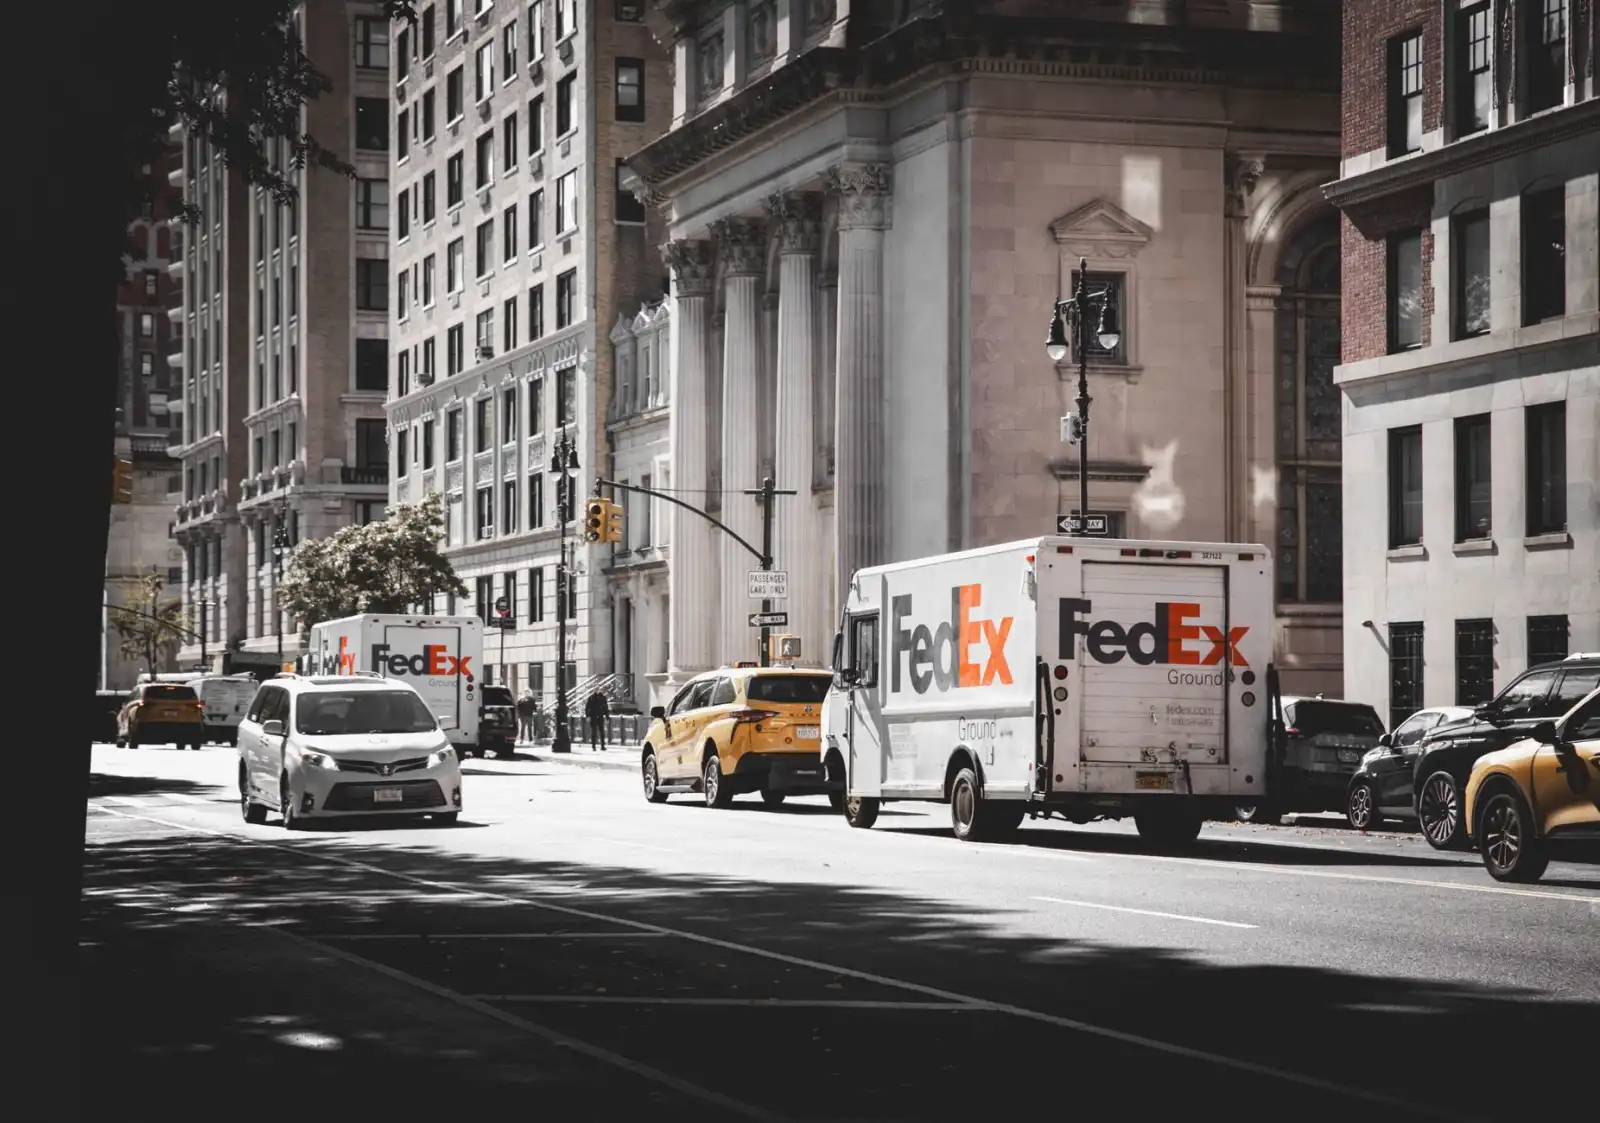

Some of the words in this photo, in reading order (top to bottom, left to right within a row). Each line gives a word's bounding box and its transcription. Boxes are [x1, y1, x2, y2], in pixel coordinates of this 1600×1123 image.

[1064, 520, 1079, 528] ONE
[750, 574, 785, 583] PASSENGER
[750, 586, 766, 594] CARS
[770, 586, 785, 594] ONLY
[891, 583, 1014, 695] FedEx
[1059, 598, 1250, 666] FedEx
[371, 644, 473, 676] FedEx
[1167, 669, 1223, 686] Ground
[958, 715, 997, 741] Ground
